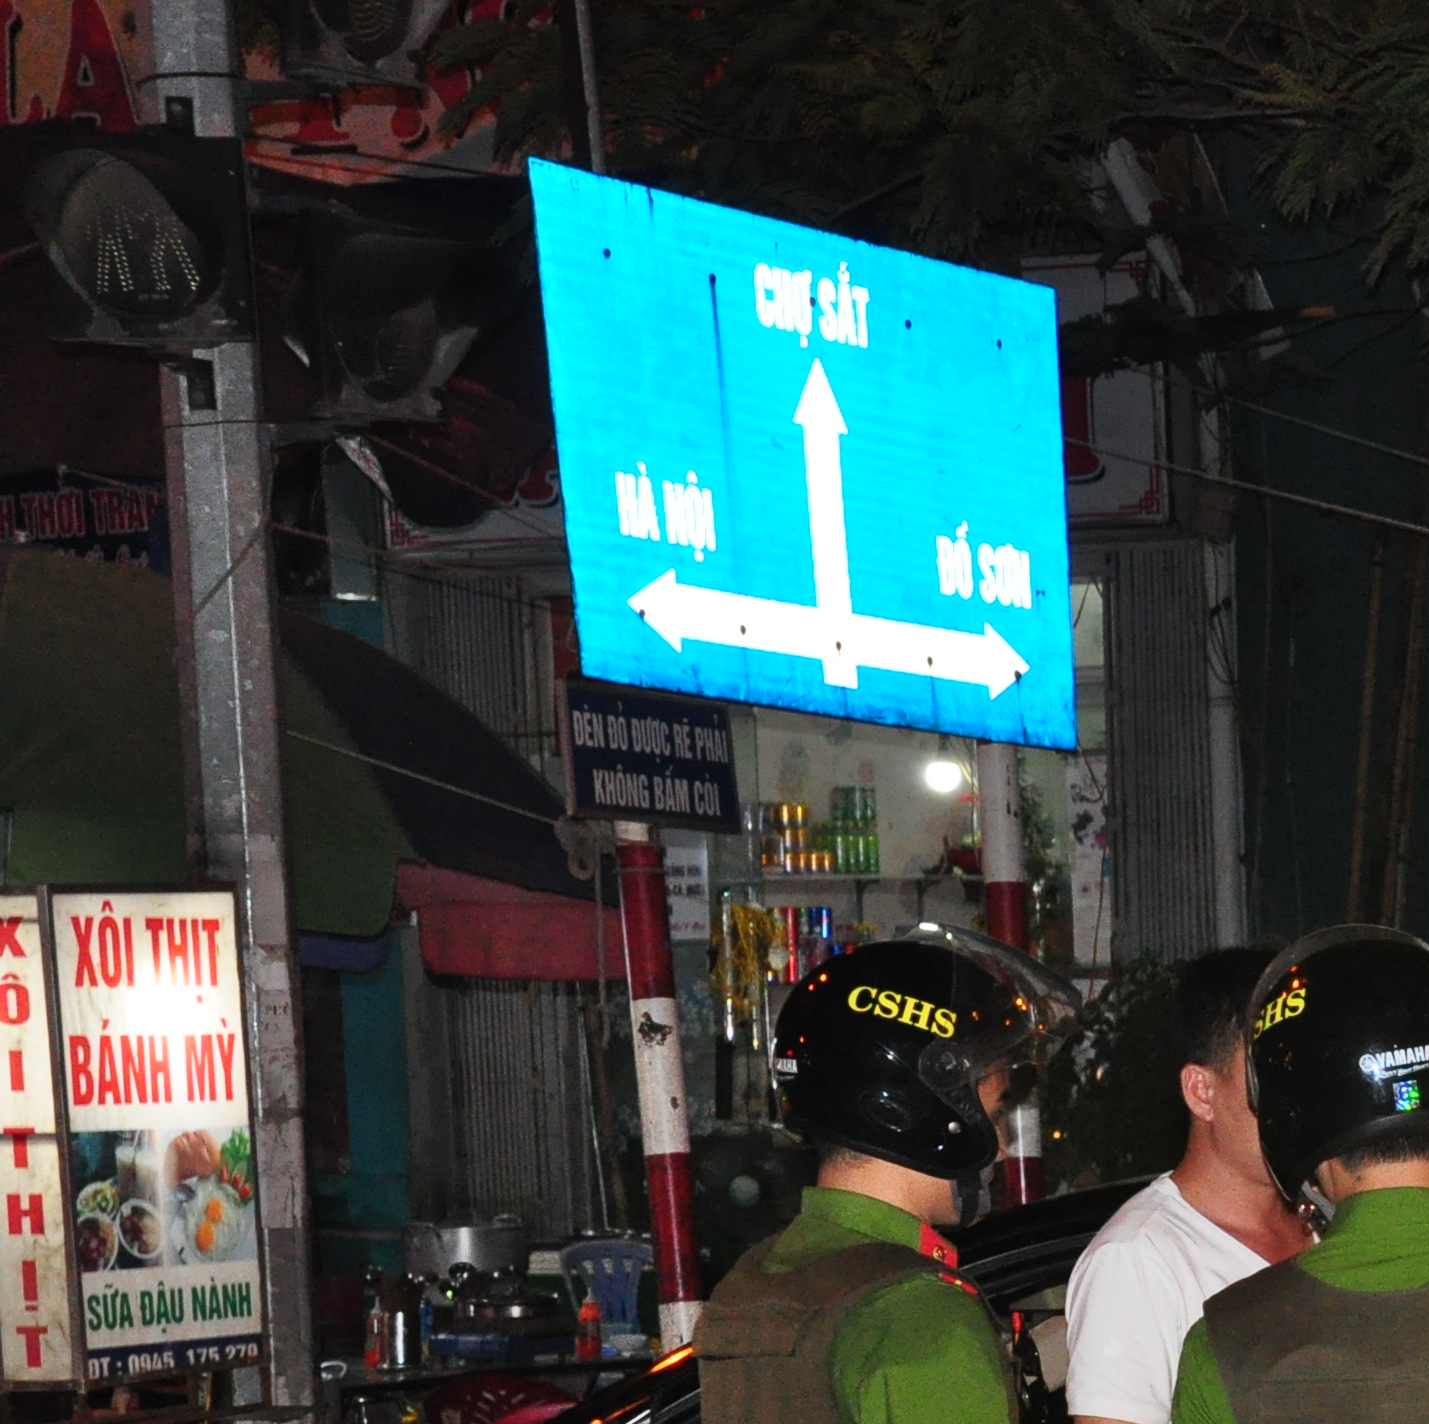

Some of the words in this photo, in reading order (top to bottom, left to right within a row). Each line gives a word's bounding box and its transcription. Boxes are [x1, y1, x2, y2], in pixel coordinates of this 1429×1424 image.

[753, 261, 813, 349] CHỢ
[816, 260, 871, 349] SẮT
[614, 460, 661, 542] HÀ
[661, 469, 717, 563] NỘI
[976, 542, 1033, 611] SƠN
[572, 703, 605, 749] ĐÈN
[606, 700, 629, 751] ĐỎ
[630, 716, 671, 763] ĐƯỢC
[694, 714, 729, 764] PHẢI
[592, 763, 651, 809] KHÔNG
[653, 764, 691, 814] BẤM
[693, 772, 722, 817] CÒI
[69, 898, 136, 989] XÔI
[145, 917, 220, 1003] THỊT
[847, 985, 958, 1038] CSHS
[68, 1018, 173, 1106] BÁNH
[184, 1017, 236, 1102] MỲ
[87, 1284, 134, 1331] SỮA
[139, 1280, 185, 1334] ĐẬU
[190, 1275, 252, 1322] NÀNH
[186, 1346, 219, 1367] 175
